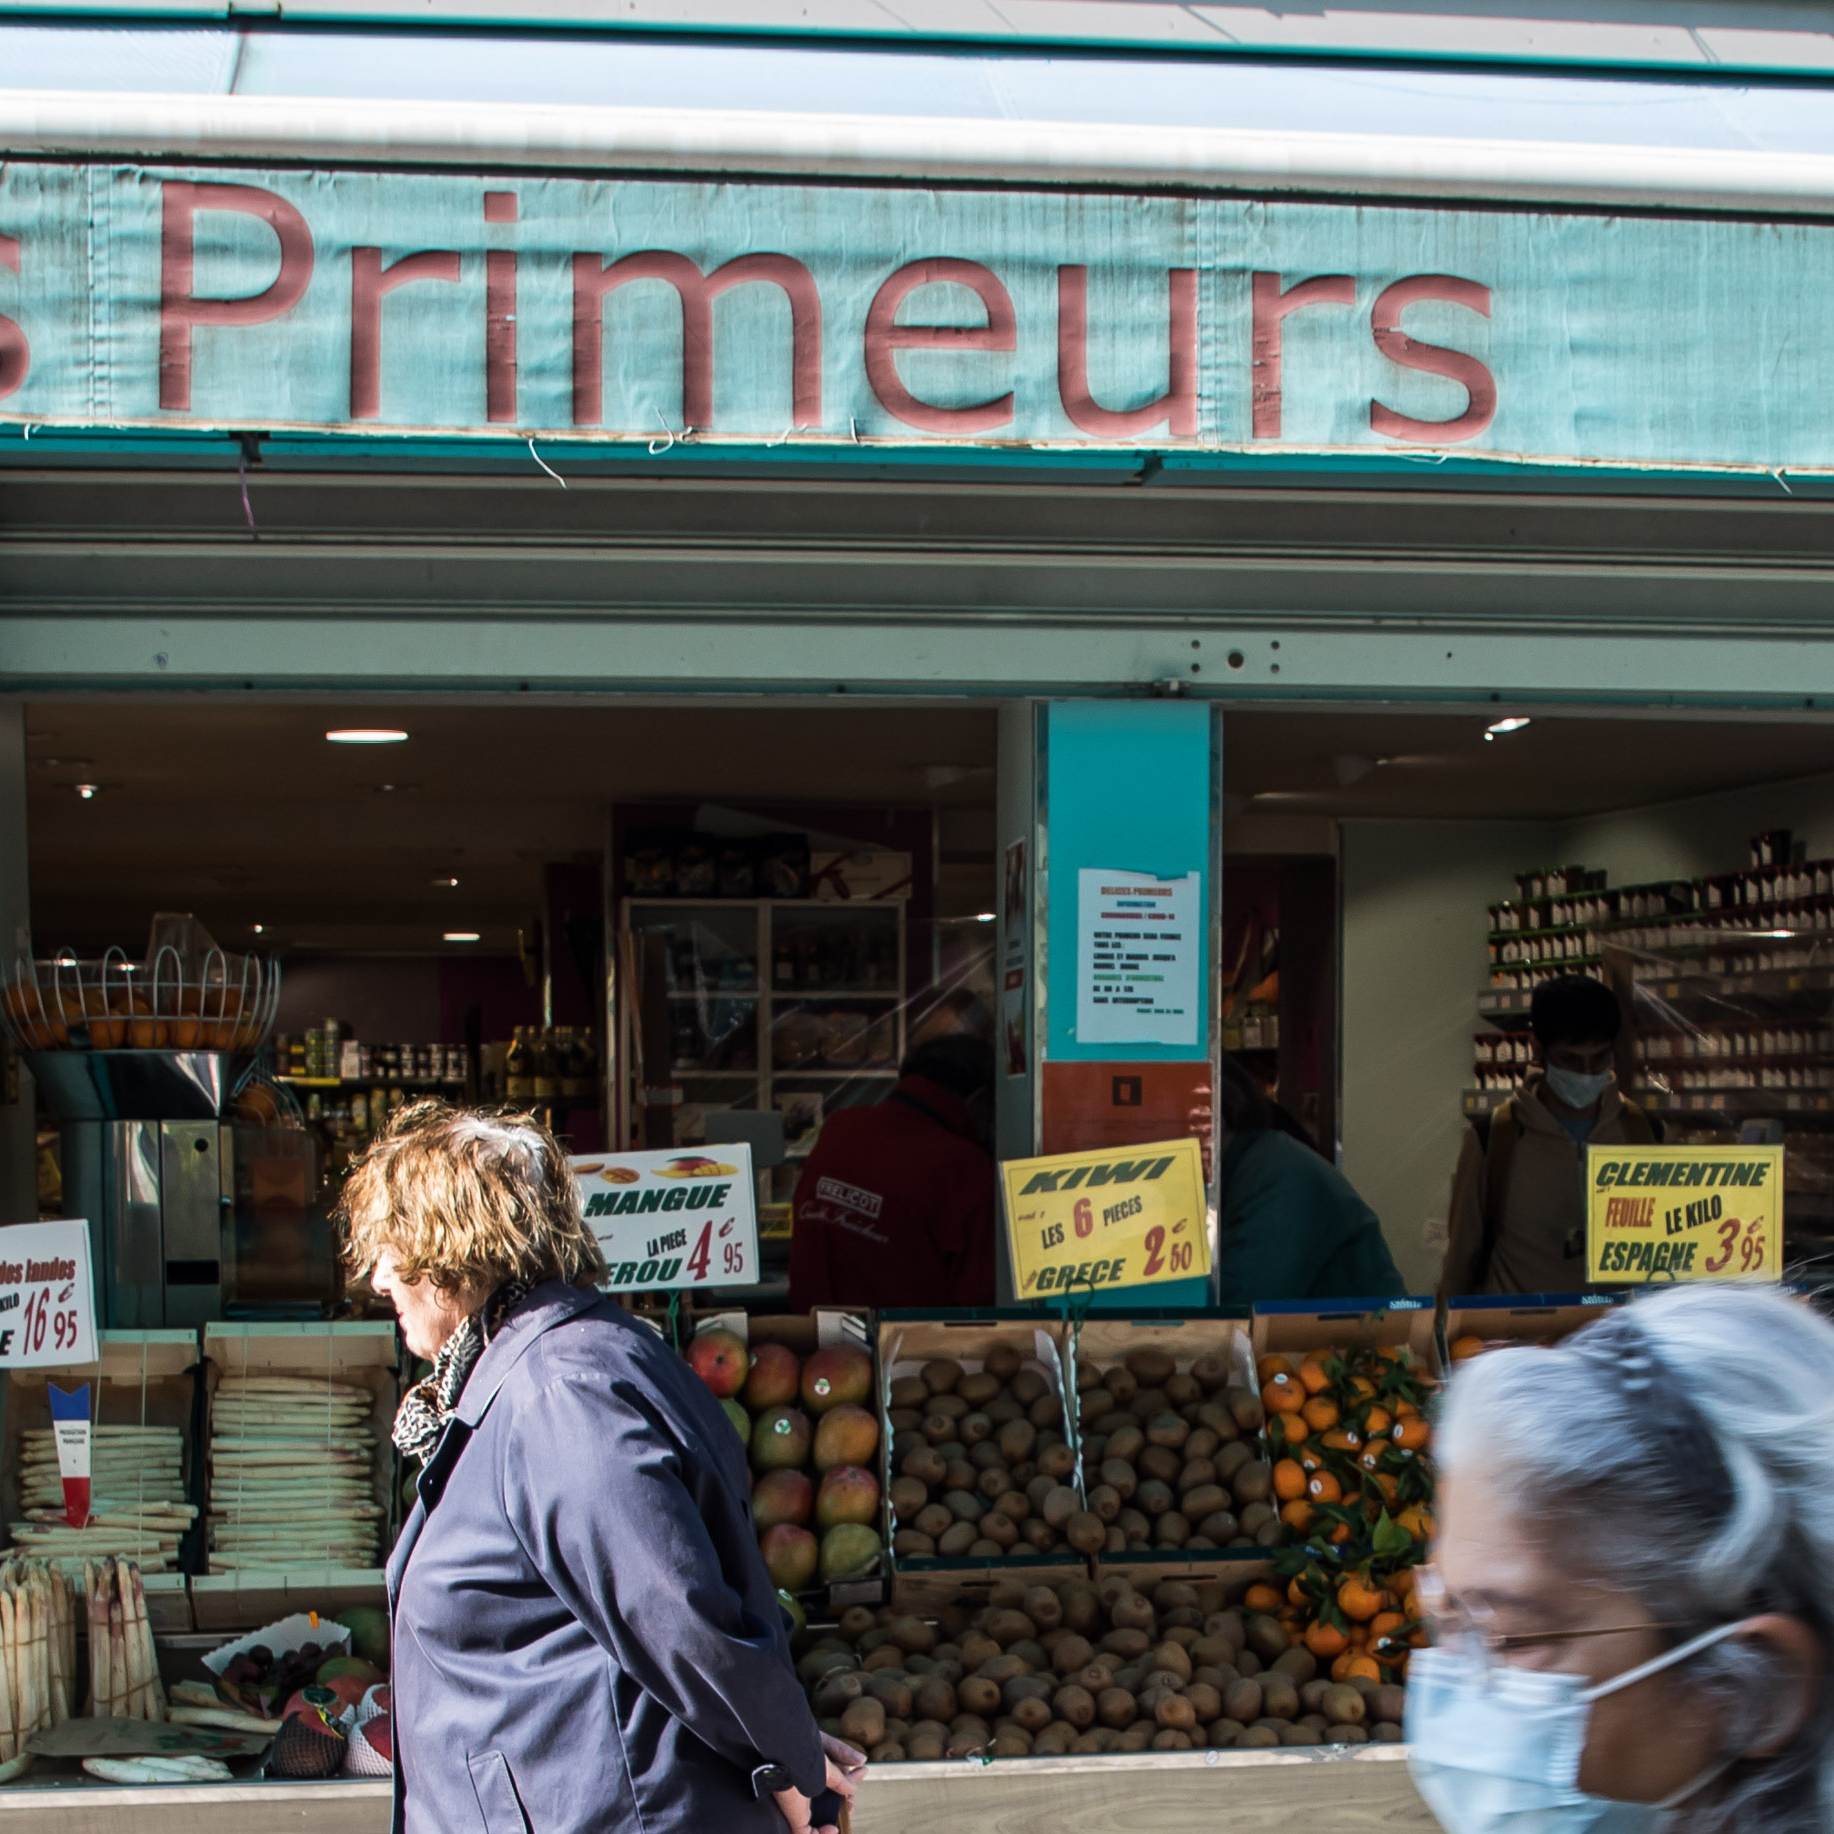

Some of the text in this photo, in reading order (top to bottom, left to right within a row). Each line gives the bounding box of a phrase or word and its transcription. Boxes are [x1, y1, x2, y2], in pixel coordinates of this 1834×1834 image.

[159, 180, 1498, 445] Primeurs
[1018, 1155, 1176, 1195] KIWI
[1595, 1161, 1771, 1187] CLEMENTINE
[583, 1183, 733, 1218] MANGUE
[1604, 1193, 1724, 1236] FEUILLE LE KILO
[1040, 1194, 1143, 1250] LES 6 PIECES
[647, 1239, 659, 1258] LA
[659, 1228, 688, 1252] PIECE
[686, 1219, 713, 1281] 4
[723, 1241, 744, 1275] 95
[1143, 1224, 1166, 1277] 2
[1598, 1241, 1699, 1273] ESPAGNE
[1705, 1217, 1742, 1273] 3
[1740, 1235, 1766, 1273] 95
[24, 1256, 76, 1284] landes
[605, 1257, 684, 1285] EROU
[1035, 1257, 1127, 1292] GRECE
[23, 1286, 51, 1356] 16
[53, 1309, 78, 1350] 95
